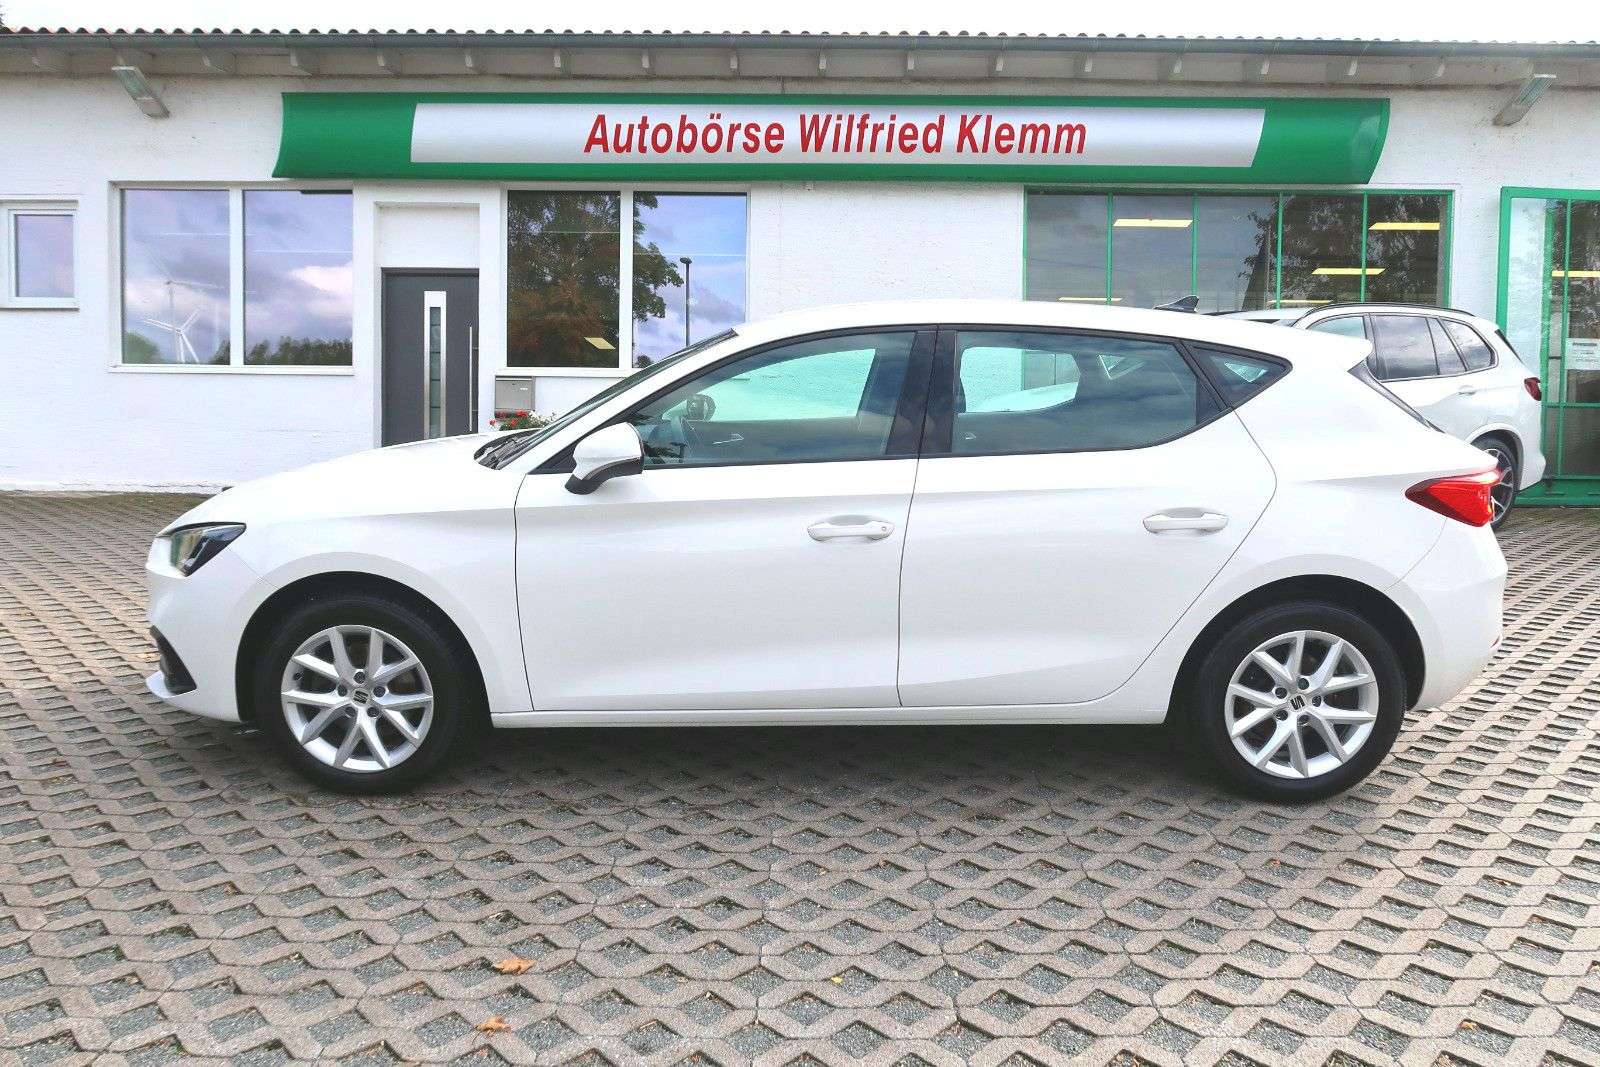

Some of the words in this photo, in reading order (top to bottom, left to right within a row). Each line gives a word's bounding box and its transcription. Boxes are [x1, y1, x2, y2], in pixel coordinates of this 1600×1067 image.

[583, 113, 785, 153] Autobörse
[799, 113, 945, 153] Wilfried
[955, 114, 1086, 153] Klemm
